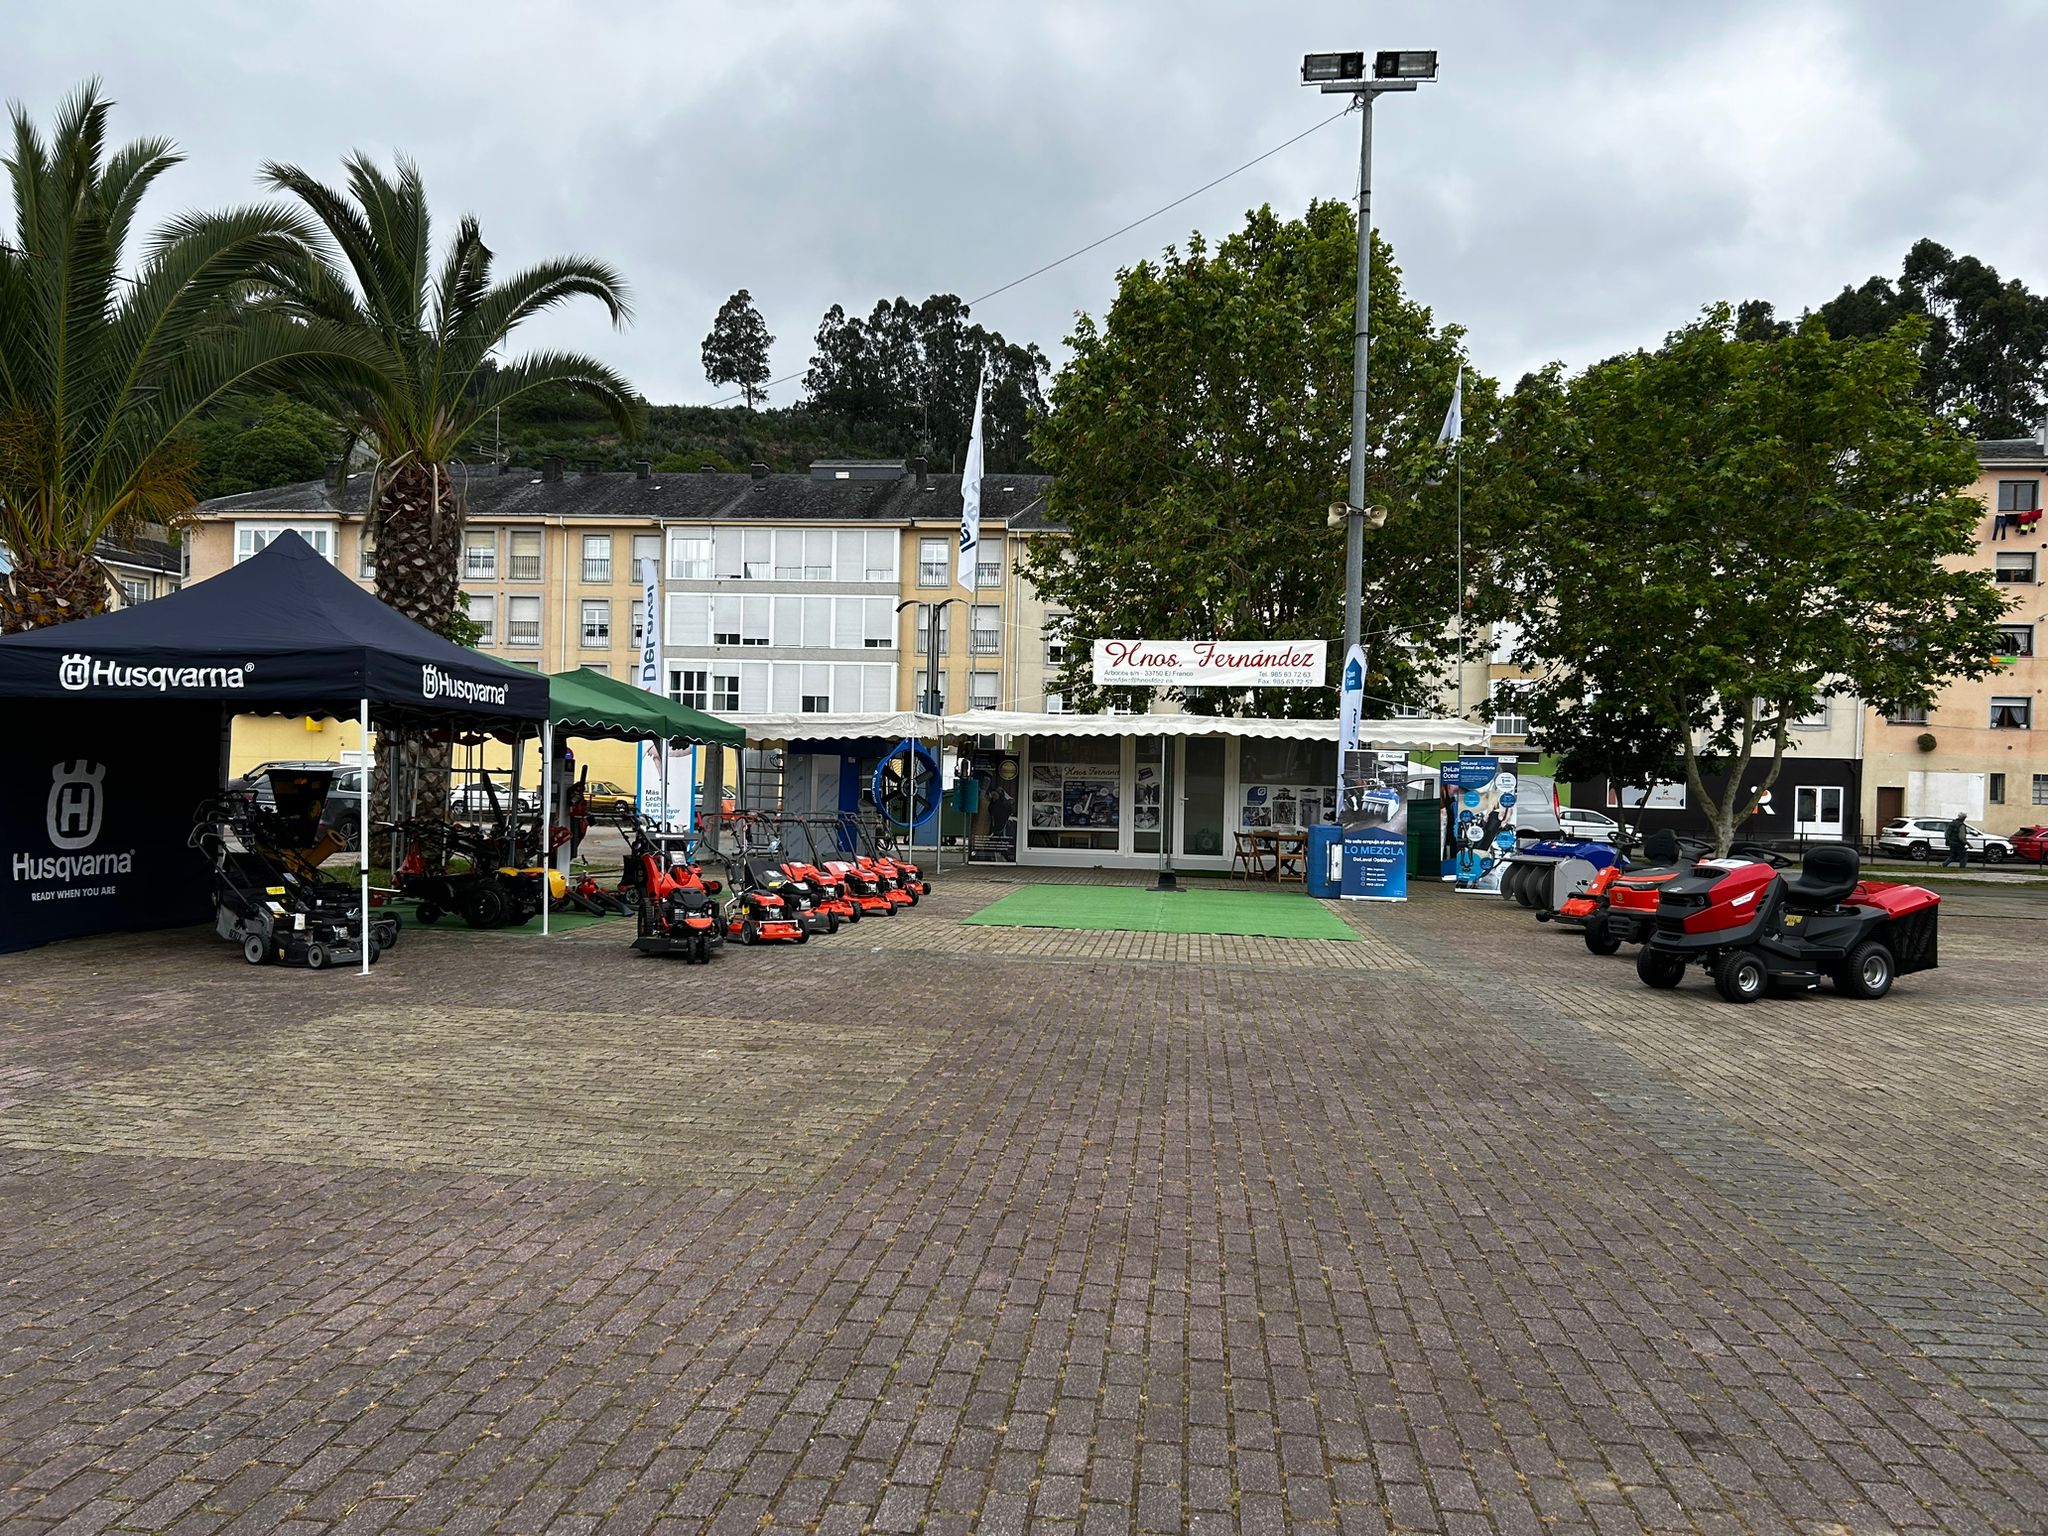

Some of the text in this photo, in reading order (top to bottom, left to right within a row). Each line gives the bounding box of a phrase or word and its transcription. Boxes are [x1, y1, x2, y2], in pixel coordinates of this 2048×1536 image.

[1105, 642, 1314, 668] Hnos. Fernández
[1344, 845, 1404, 856] LO MEZCLA
[31, 886, 116, 901] READY WHEN YOU ARE
